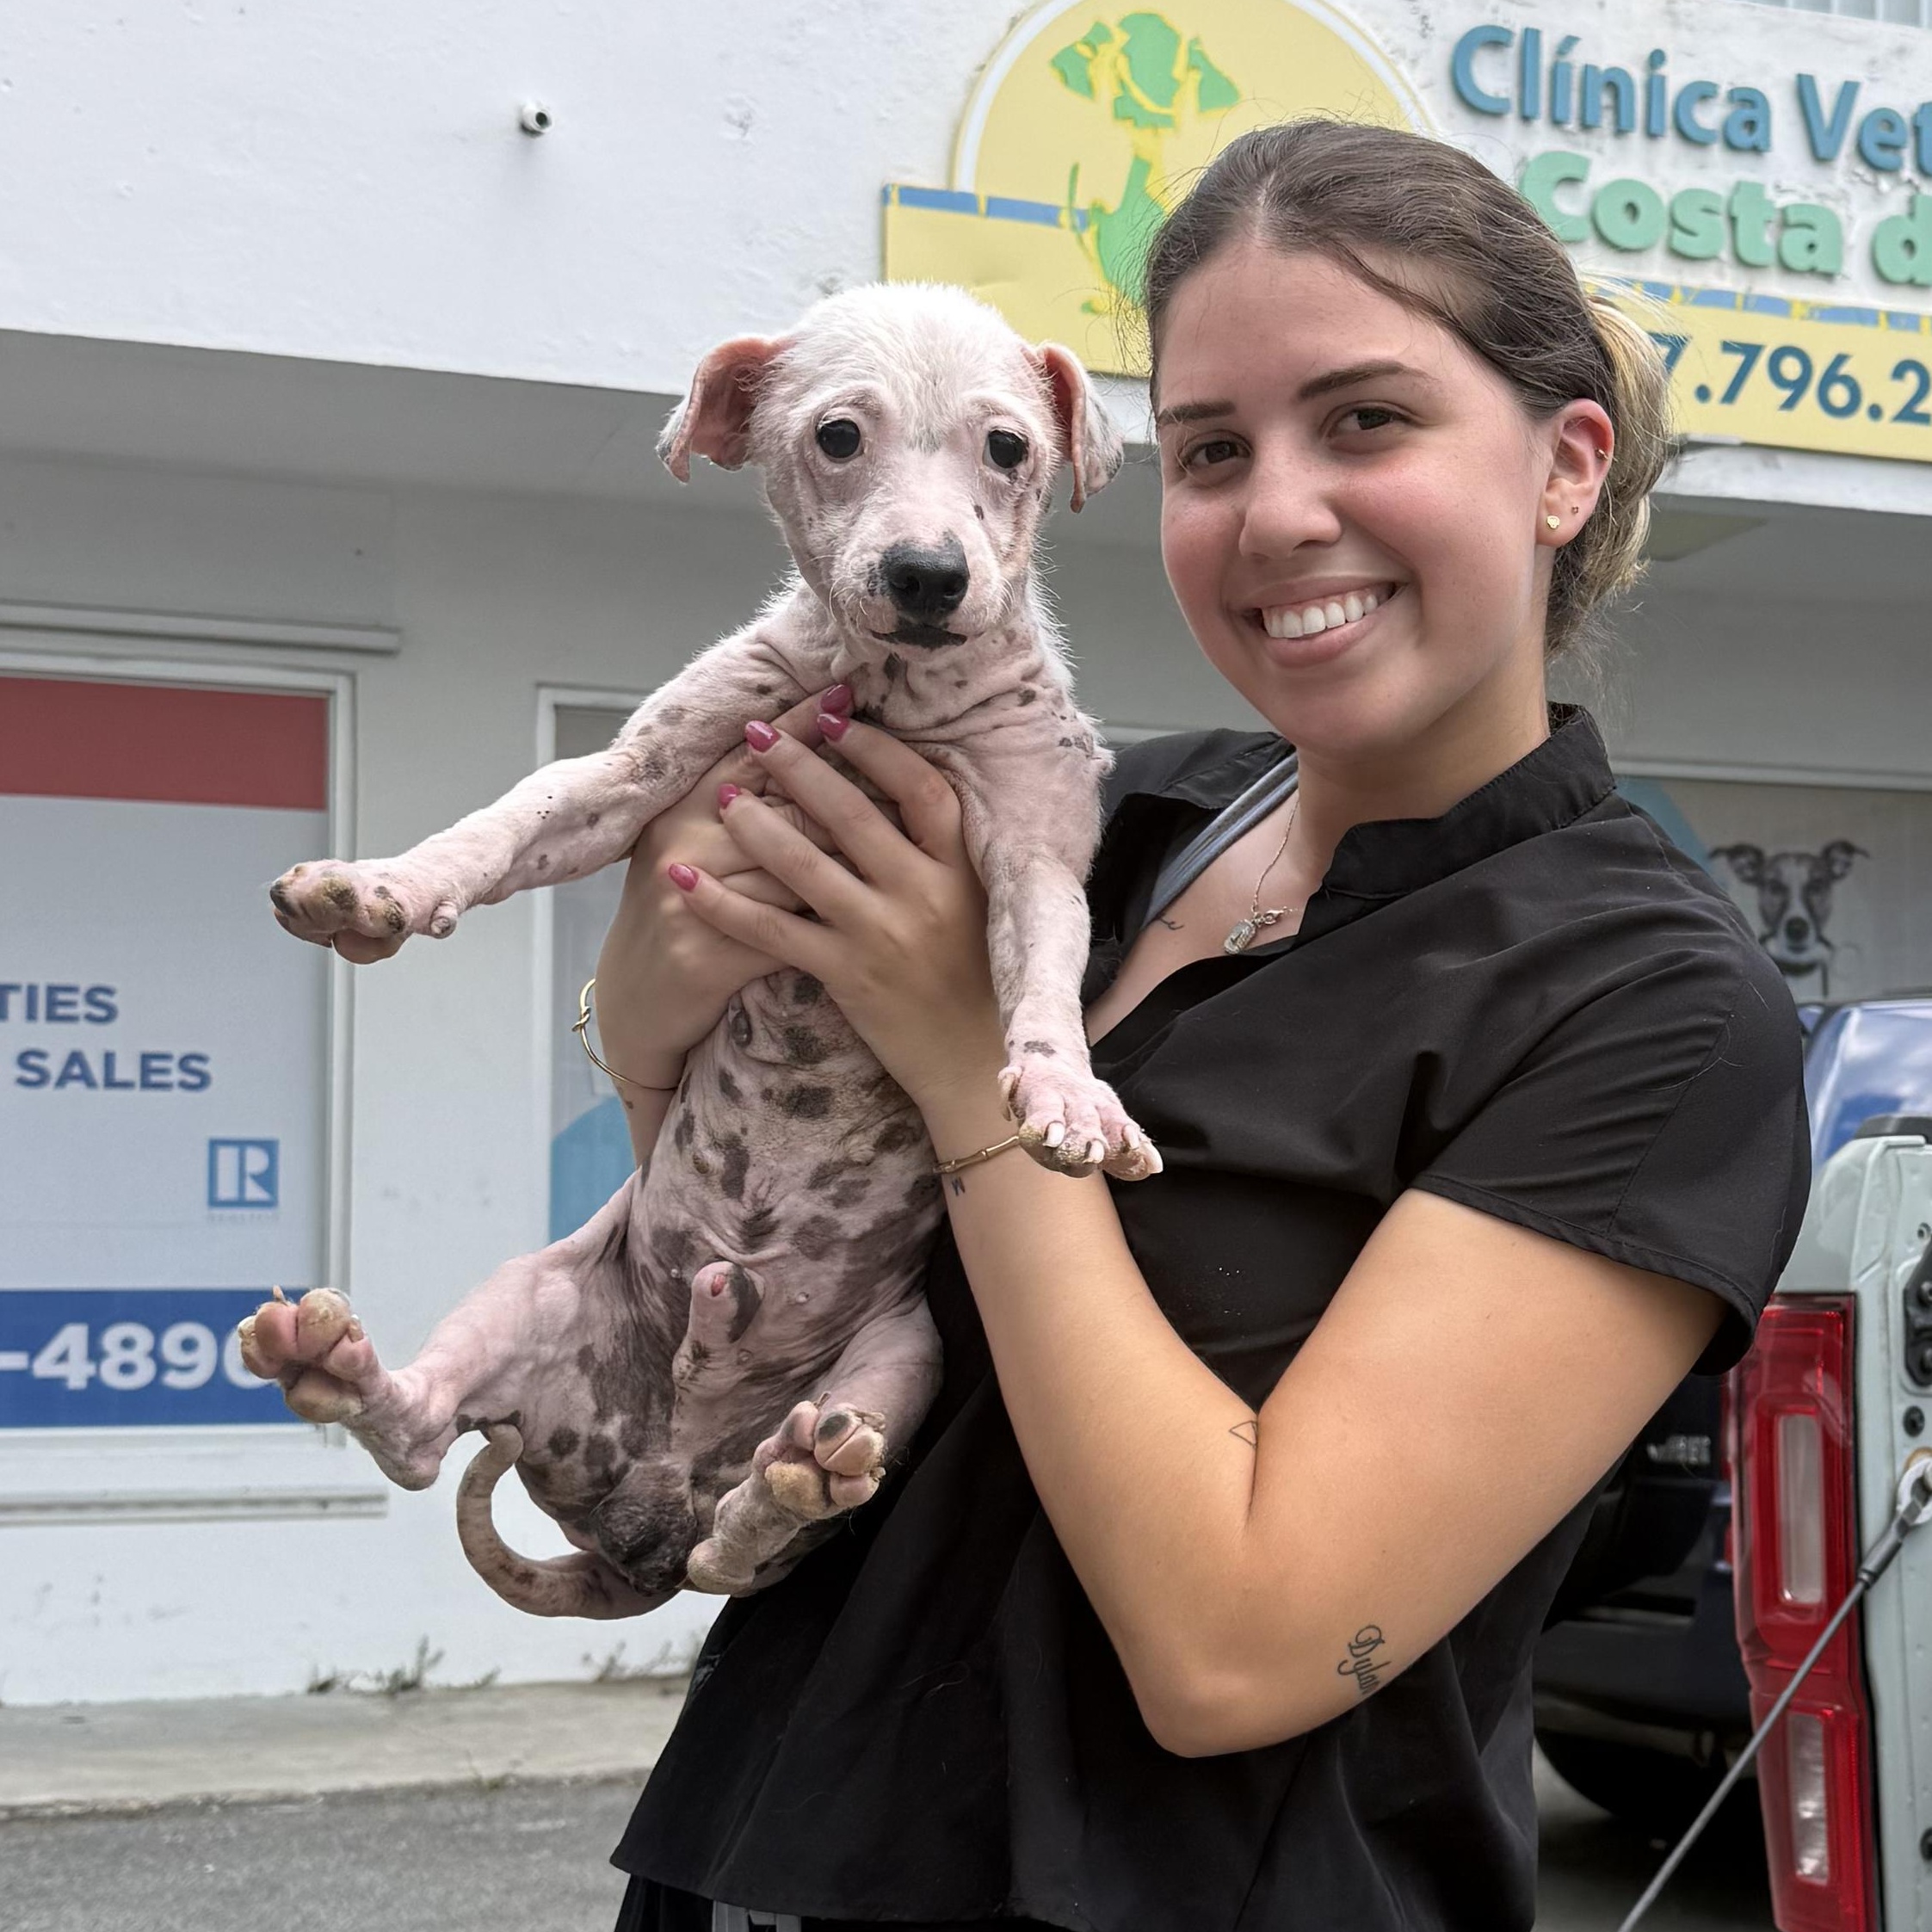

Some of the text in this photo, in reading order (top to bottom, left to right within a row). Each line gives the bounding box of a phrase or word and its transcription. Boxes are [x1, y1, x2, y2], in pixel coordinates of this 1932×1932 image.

[1451, 24, 1771, 154] Clínica
[1519, 150, 1843, 277] Costa
[15, 1047, 213, 1092] SALES
